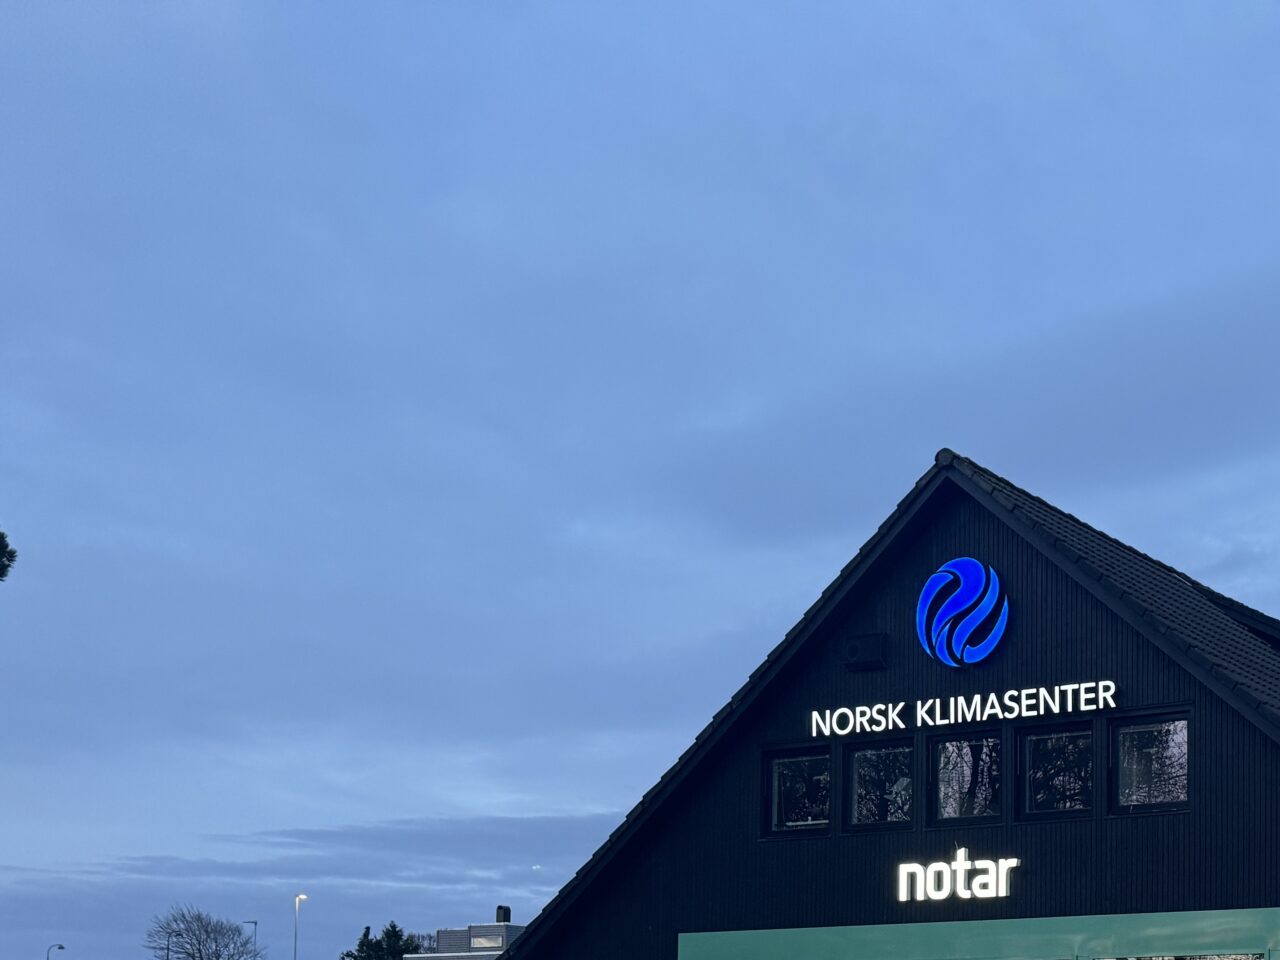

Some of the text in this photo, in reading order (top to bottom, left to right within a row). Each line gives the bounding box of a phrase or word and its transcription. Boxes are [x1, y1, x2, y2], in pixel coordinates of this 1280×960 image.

[811, 680, 1117, 737] NORSK KLIMASENTER
[898, 847, 1019, 902] notar
